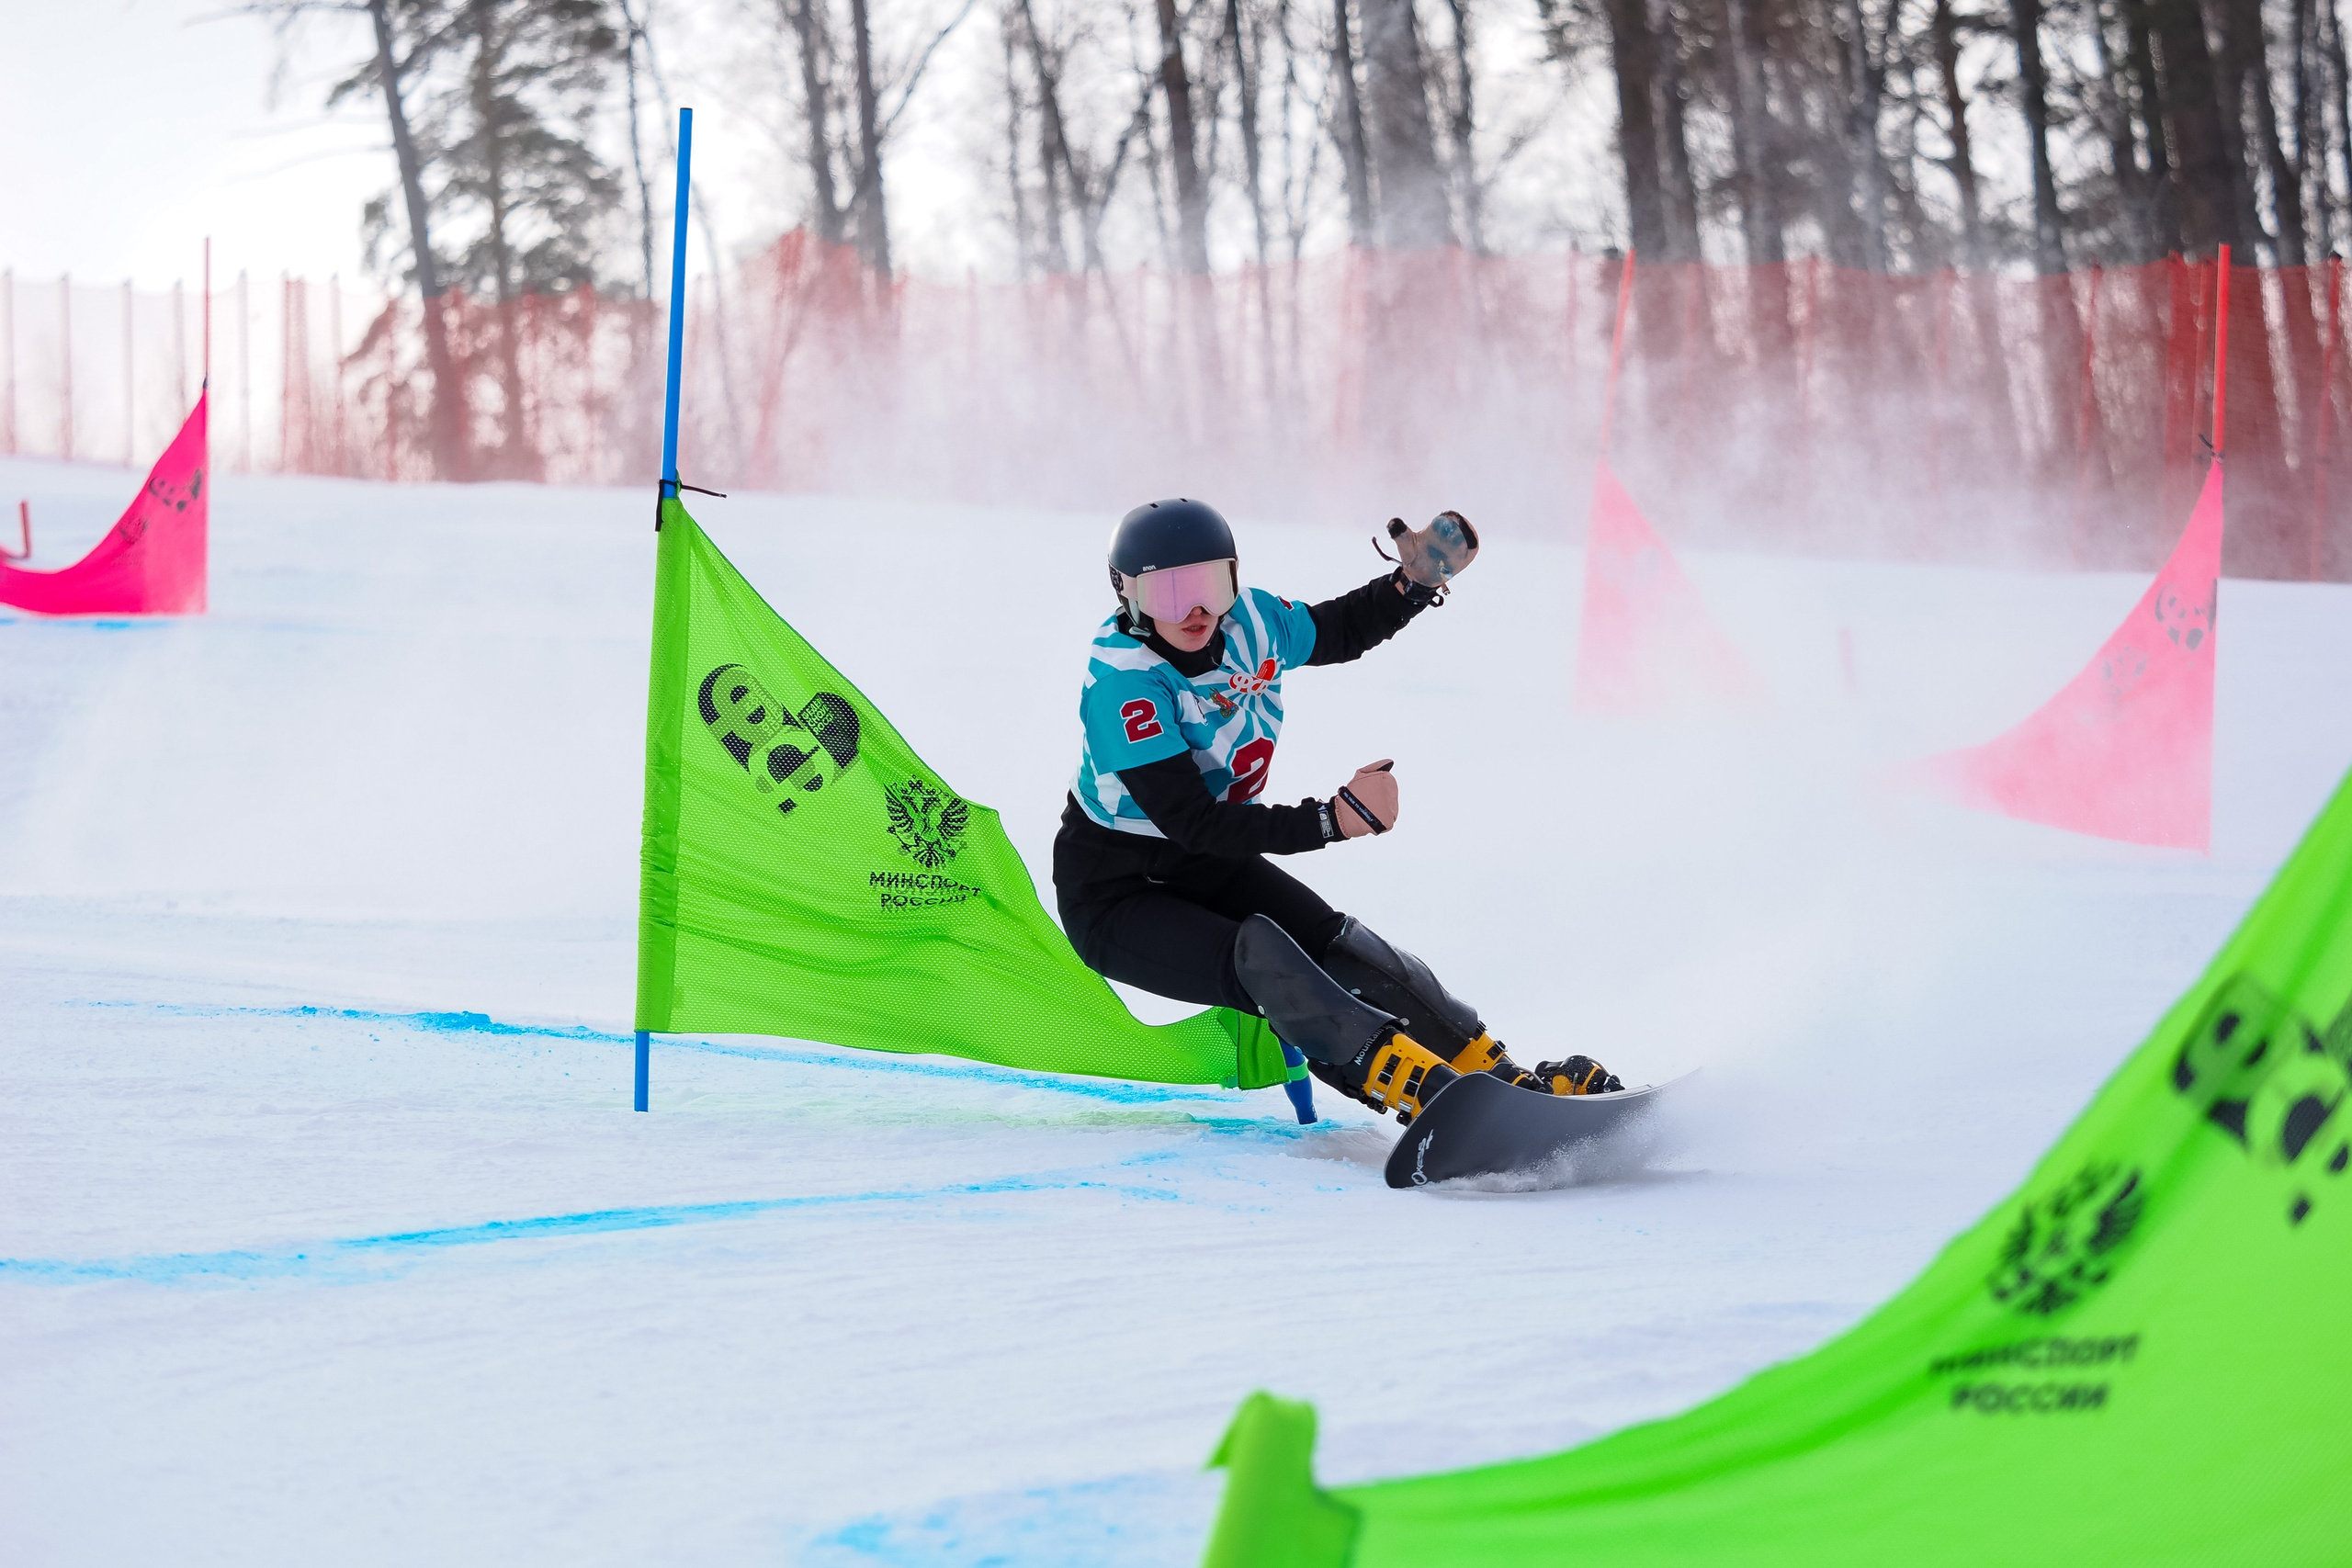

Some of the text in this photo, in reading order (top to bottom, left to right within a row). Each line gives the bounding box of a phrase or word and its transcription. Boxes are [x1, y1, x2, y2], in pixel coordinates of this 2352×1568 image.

[1120, 698, 1164, 743] 2
[1227, 738, 1274, 805] 2
[869, 871, 981, 897] МИНСПОРТ
[1950, 1382, 2110, 1415] РОССИИ
